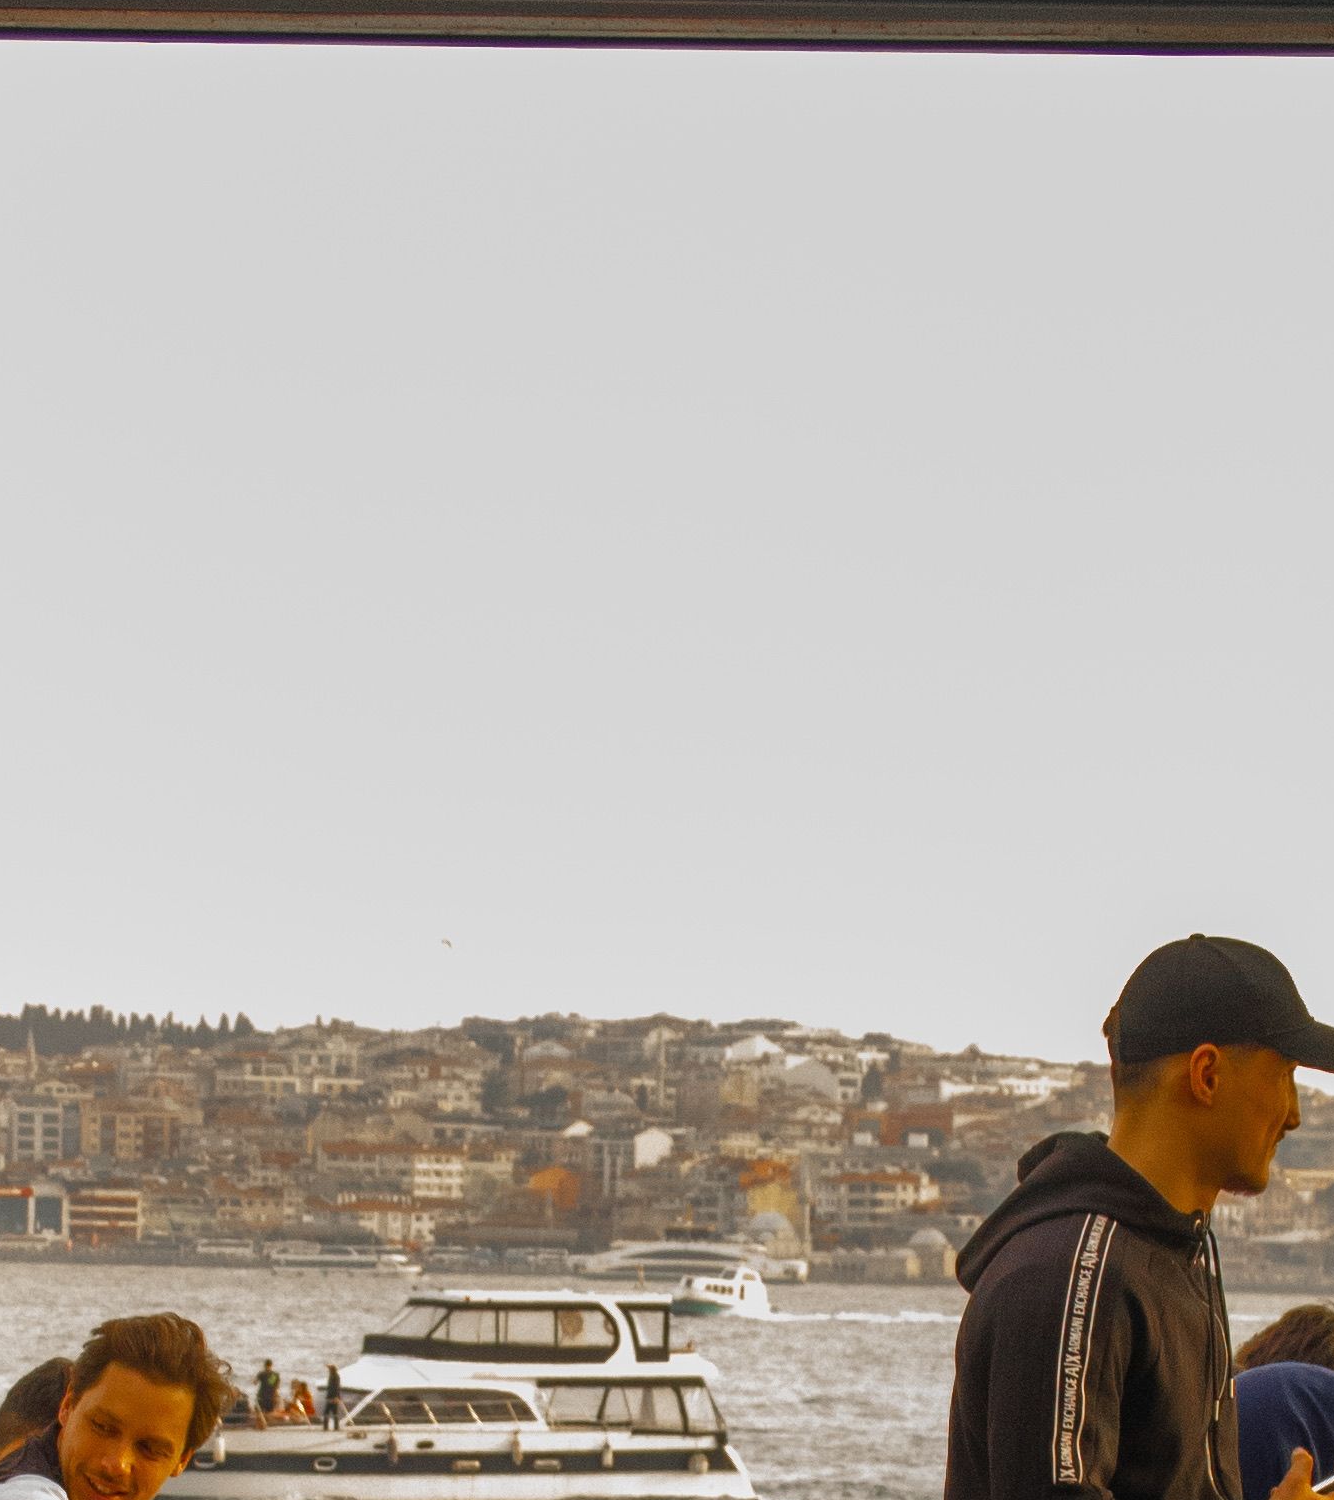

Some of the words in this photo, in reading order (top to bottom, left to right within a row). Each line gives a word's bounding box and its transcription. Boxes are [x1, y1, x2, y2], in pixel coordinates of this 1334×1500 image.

[1073, 1269, 1093, 1315] EXCHANGE
[1068, 1316, 1084, 1355] ARMANI
[1062, 1378, 1079, 1430] EXCHANGE
